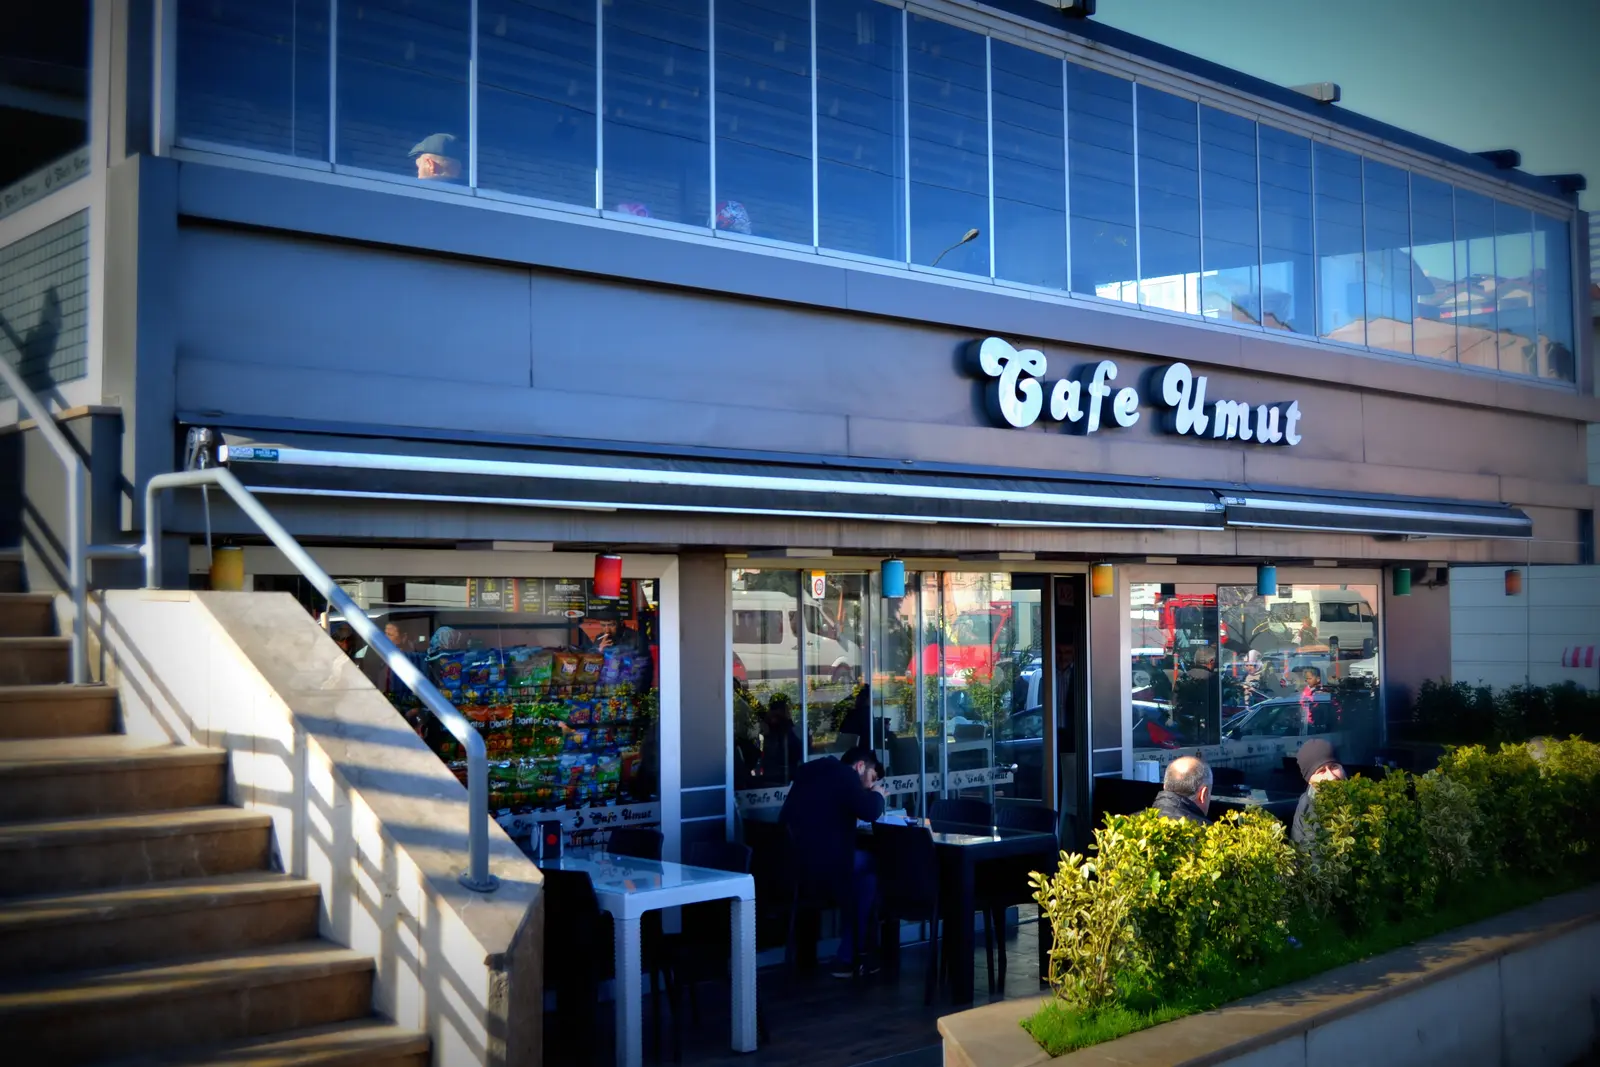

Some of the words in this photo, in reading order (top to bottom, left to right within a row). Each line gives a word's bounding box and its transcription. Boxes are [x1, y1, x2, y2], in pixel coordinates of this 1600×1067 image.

[979, 336, 1140, 435] Cafe
[1162, 361, 1303, 446] Umut
[892, 779, 914, 791] Cafe
[746, 792, 771, 805] Cafe
[589, 811, 618, 826] Cafe
[621, 808, 653, 821] Umut
